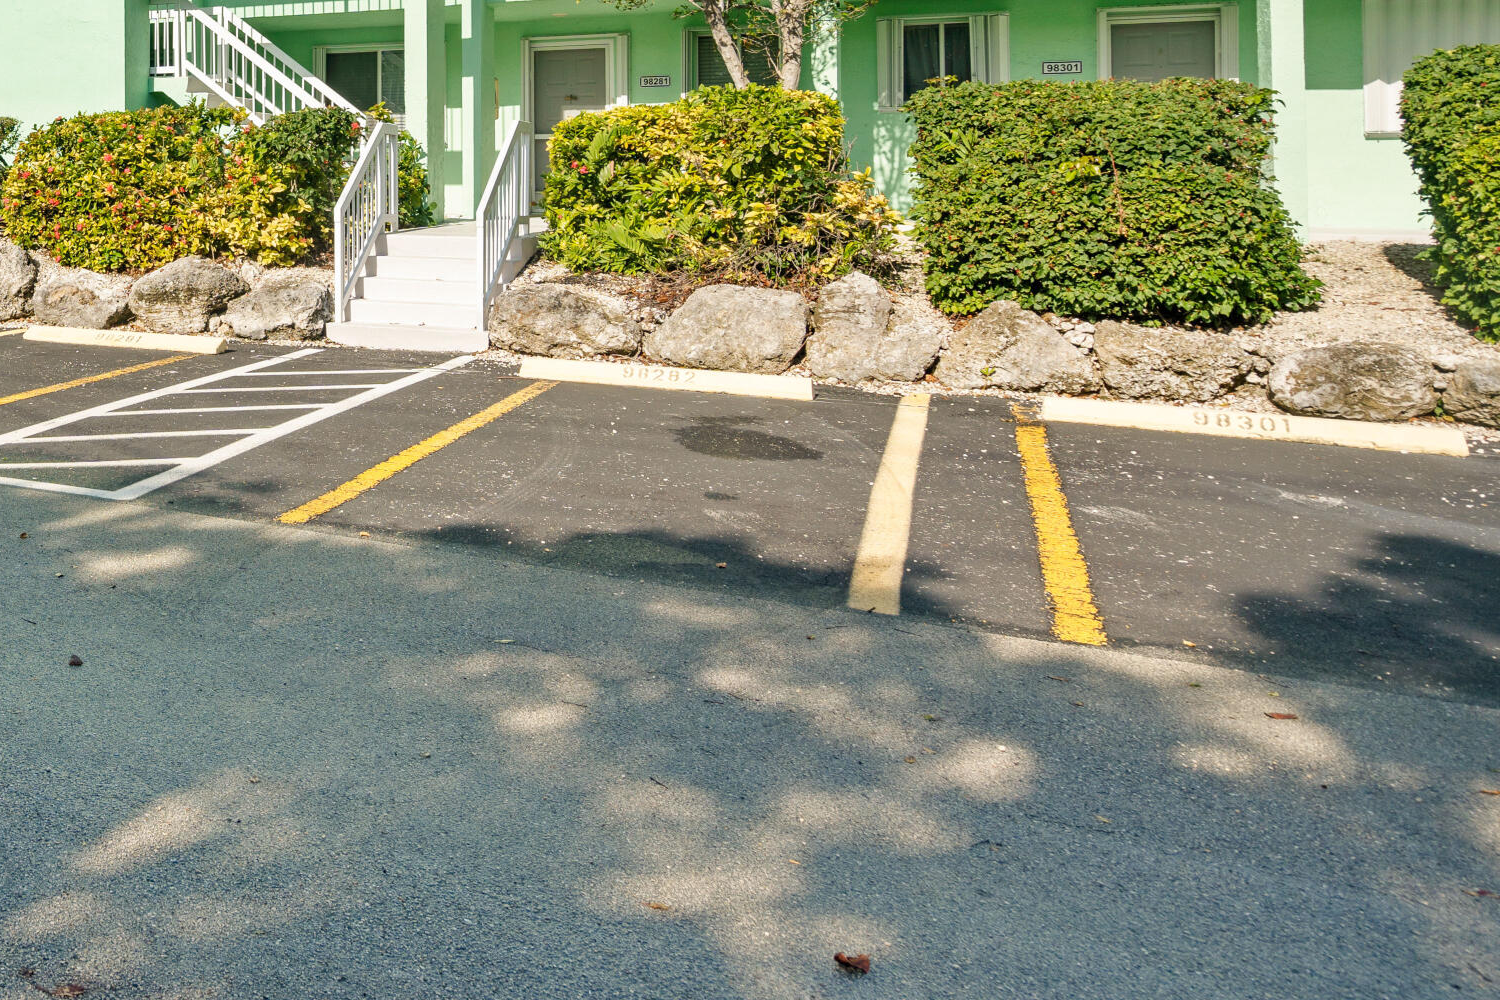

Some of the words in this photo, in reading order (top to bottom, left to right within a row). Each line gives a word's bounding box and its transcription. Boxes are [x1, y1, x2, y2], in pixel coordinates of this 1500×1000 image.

[1046, 63, 1079, 72] 98301
[643, 78, 668, 86] 98281
[1192, 411, 1290, 432] 98301
